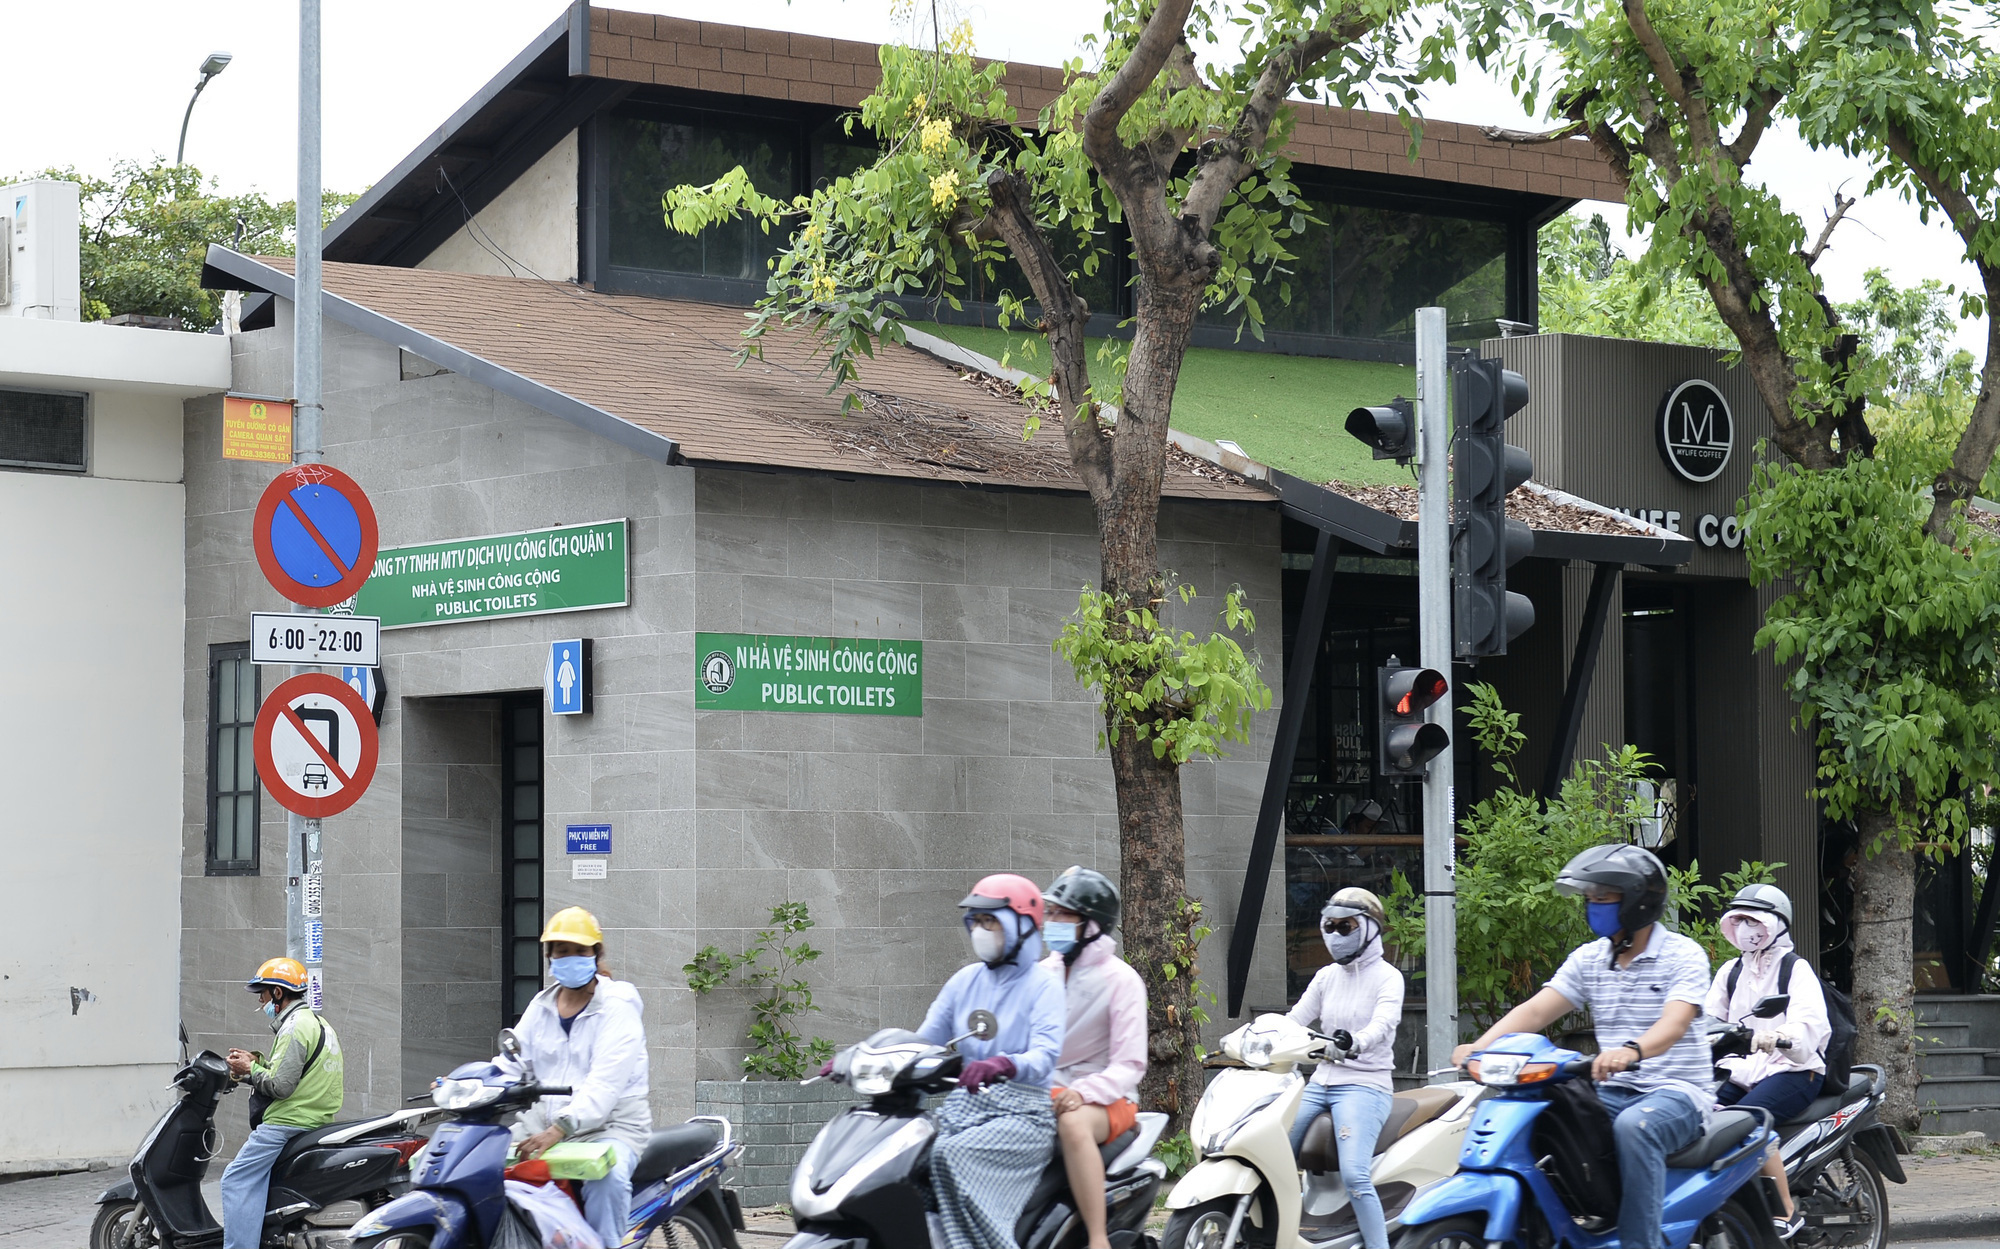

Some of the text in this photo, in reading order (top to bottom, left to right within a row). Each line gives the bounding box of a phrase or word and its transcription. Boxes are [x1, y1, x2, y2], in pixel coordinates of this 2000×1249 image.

[229, 430, 286, 443] CAMERA QUAN SÁT
[1676, 449, 1722, 459] MYLIFE COFFEE
[394, 555, 408, 575] TY
[409, 551, 439, 573] TNHH
[441, 548, 466, 570] MTV
[467, 544, 495, 570] DỊCH
[496, 543, 512, 567] VỤ
[514, 537, 546, 561] CÔNG
[548, 533, 568, 557] ÍCH
[570, 529, 605, 557] QUẬN
[607, 532, 613, 550] 1
[412, 568, 561, 598] NHÀ VỆ SINH CÔNG CỘNG
[435, 592, 537, 616] PUBLIC TOILETS
[736, 643, 918, 680] NHÀ VỆ SINH CÔNG CỘNG
[761, 683, 895, 708] PUBLIC TOILETS
[568, 831, 582, 843] PHỤC
[582, 831, 589, 843] VỤ
[580, 843, 597, 851] FREE
